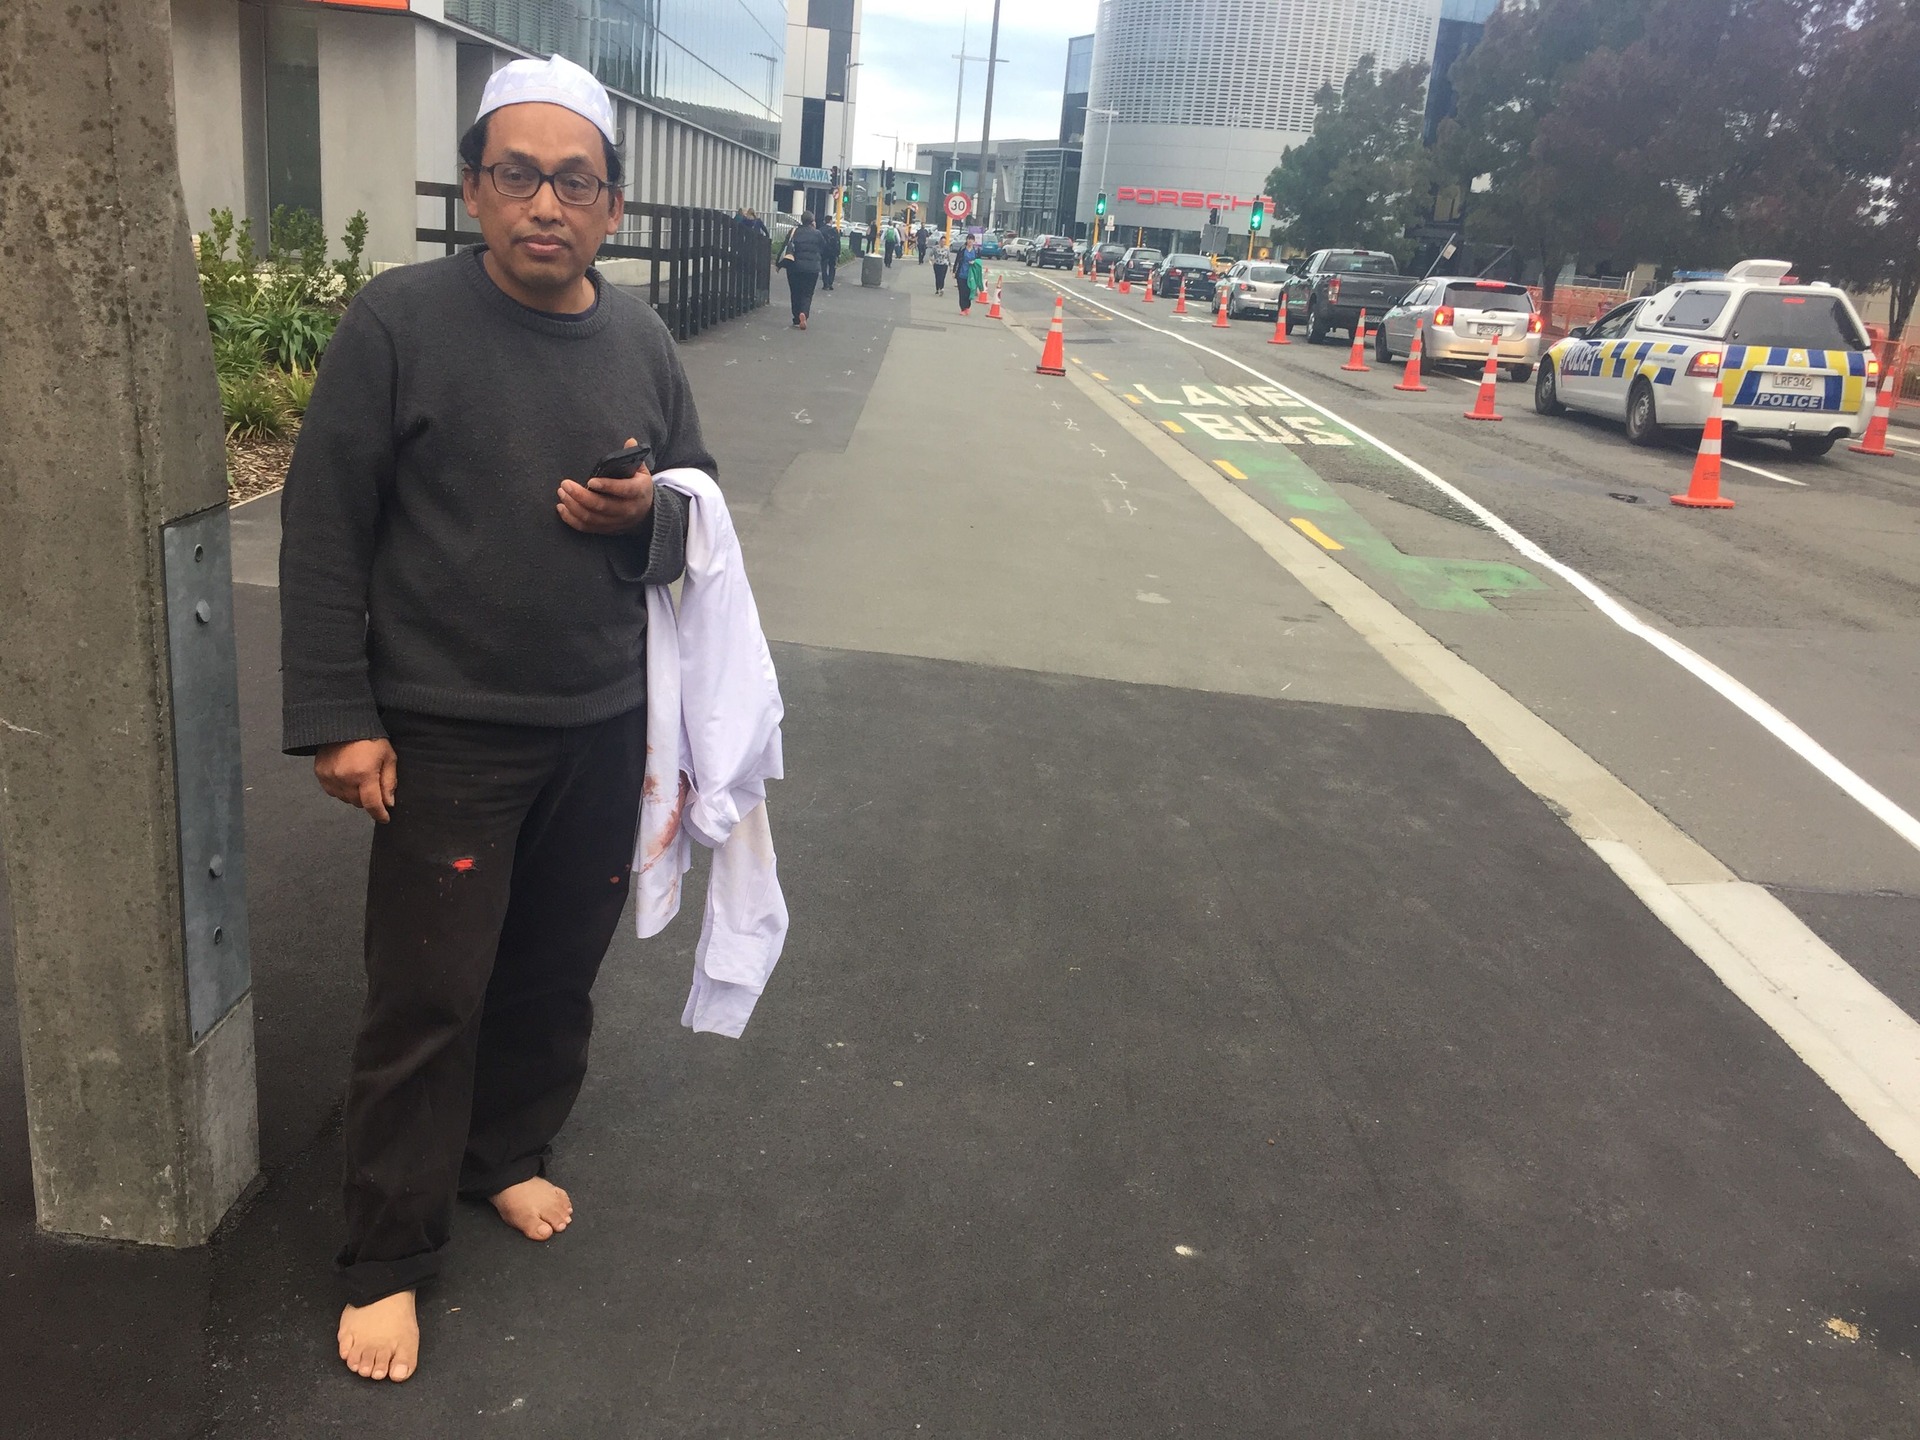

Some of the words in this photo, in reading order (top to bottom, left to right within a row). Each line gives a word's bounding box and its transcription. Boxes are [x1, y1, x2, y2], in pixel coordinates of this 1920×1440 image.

[791, 166, 829, 181] MANAWA
[950, 200, 965, 211] 30
[1117, 186, 1276, 214] PORSCHE
[1564, 345, 1592, 371] POLICE
[1774, 375, 1812, 388] LRF342
[1133, 383, 1305, 407] LANE
[1758, 393, 1820, 408] POLICE
[1178, 412, 1354, 446] BUS
